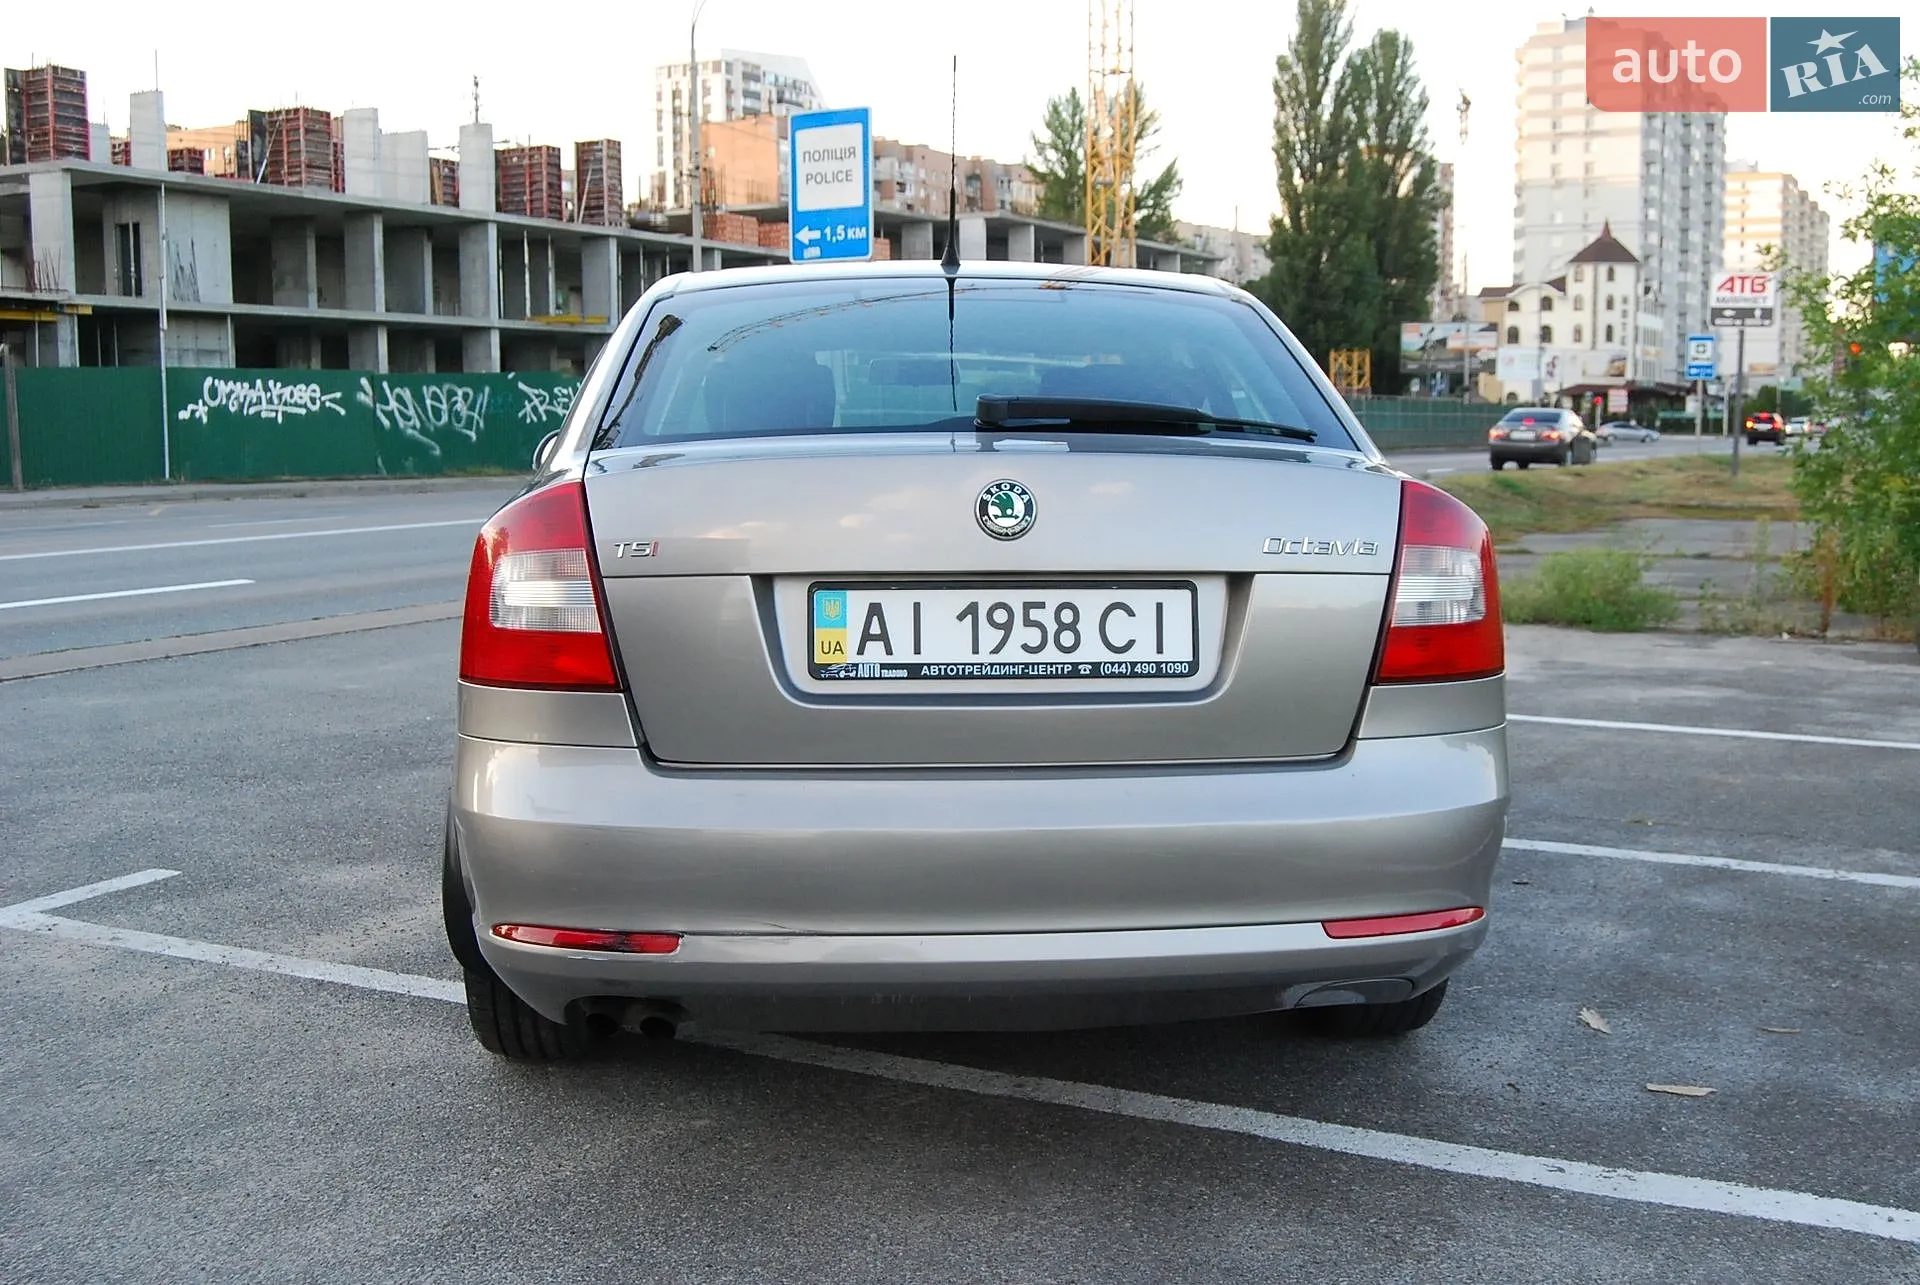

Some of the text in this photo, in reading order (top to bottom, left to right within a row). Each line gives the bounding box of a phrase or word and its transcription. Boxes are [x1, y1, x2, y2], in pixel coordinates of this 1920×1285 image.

[802, 146, 857, 163] ПОЛІЦІЯ
[805, 169, 854, 185] POLICE
[823, 224, 846, 243] 1,5
[1262, 536, 1379, 556] Octavia
[856, 601, 1164, 656] AI 1958 CI
[820, 640, 845, 655] UA
[857, 663, 881, 678] AUTO
[921, 662, 1189, 676] АВТОТРЕЙДИНГ-ЦЕНТР (044) 490 1090
